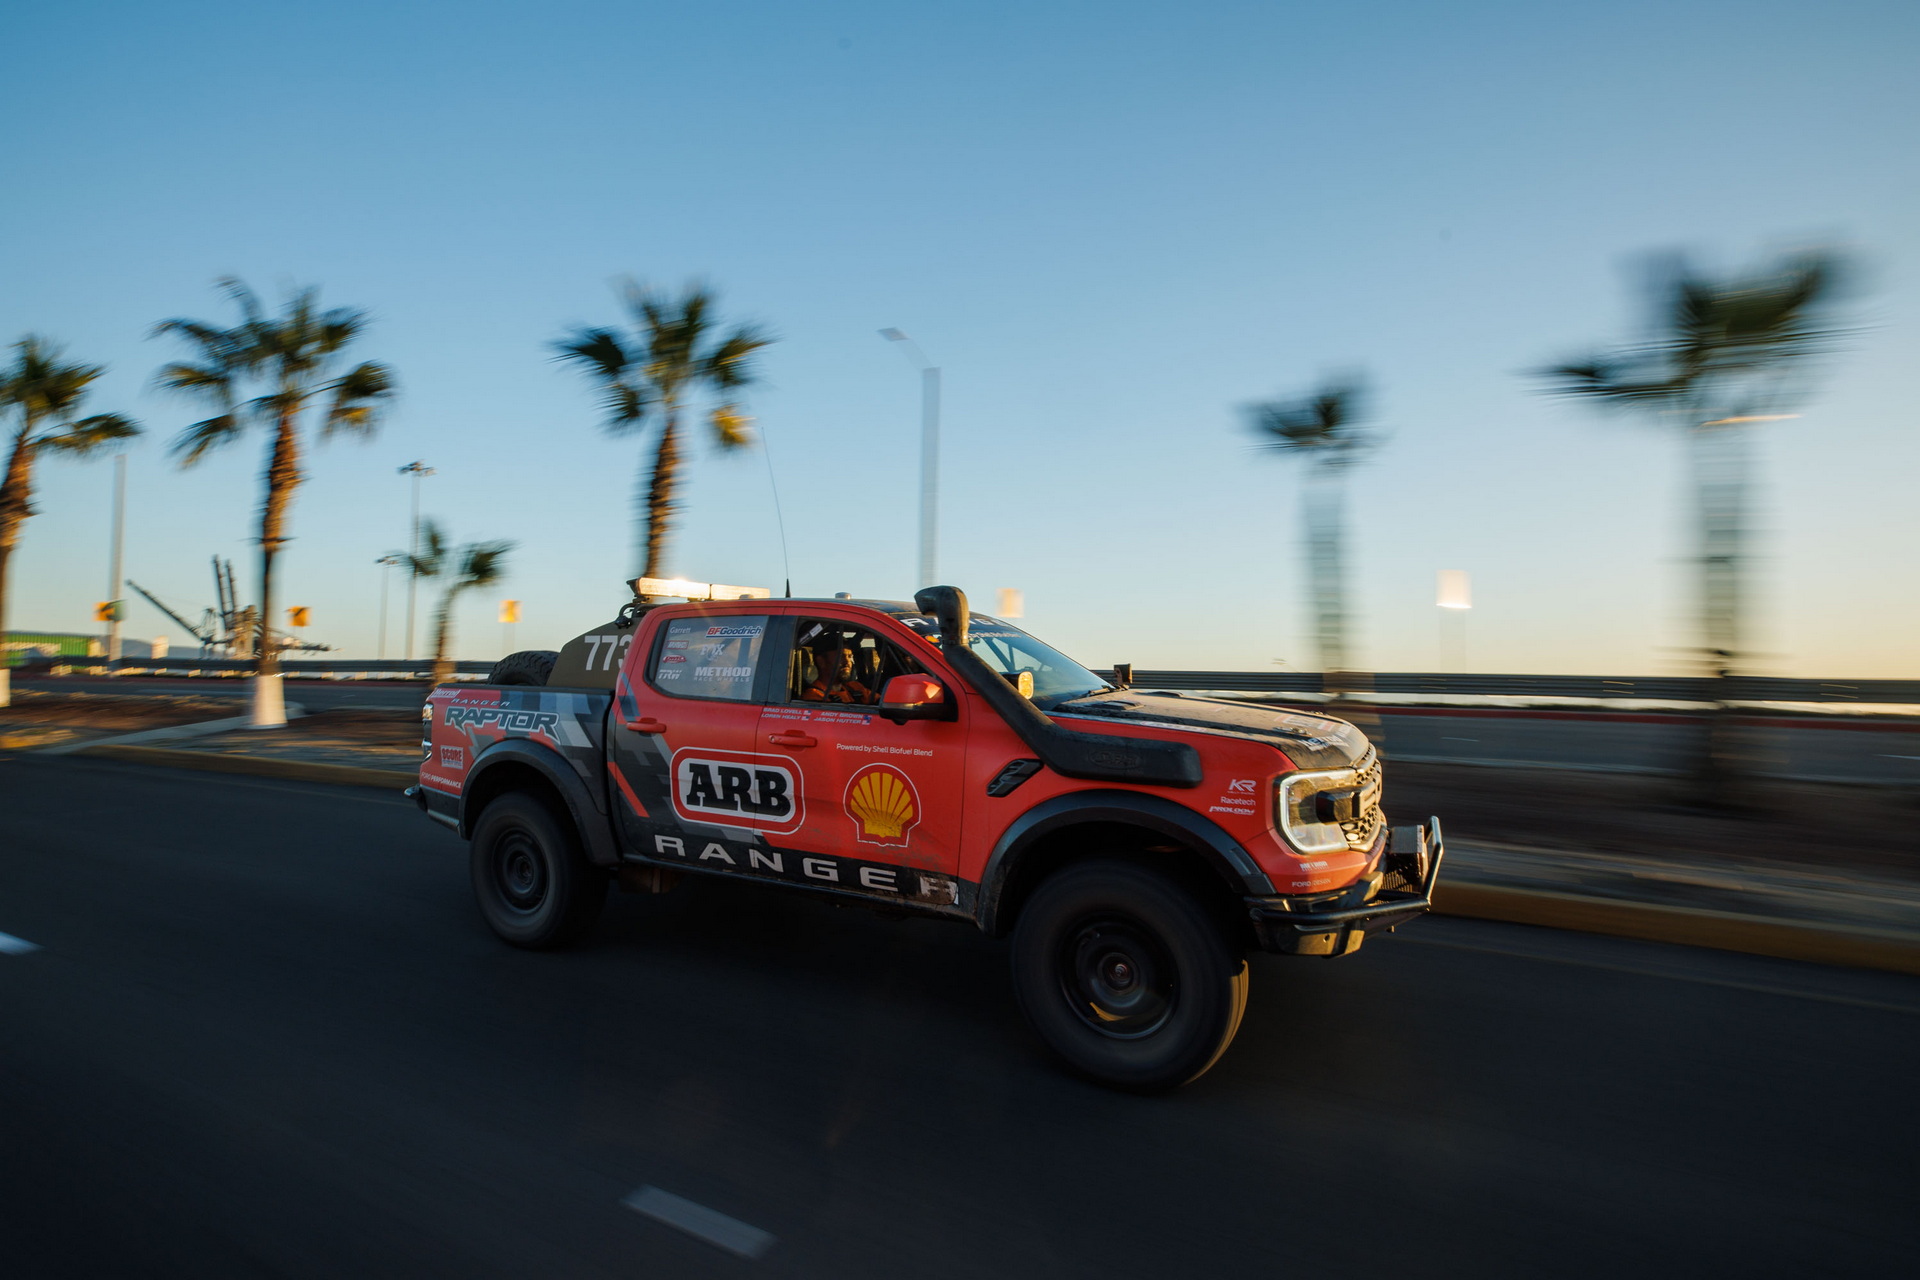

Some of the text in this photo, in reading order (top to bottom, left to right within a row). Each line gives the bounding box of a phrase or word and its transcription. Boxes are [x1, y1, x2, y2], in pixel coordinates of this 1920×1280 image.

[670, 626, 691, 635] Garrett
[706, 626, 762, 636] BFGoodrich
[658, 669, 683, 680] TRW
[695, 666, 751, 677] METHOD
[451, 698, 511, 707] RANGER
[444, 706, 561, 745] RAPTOR
[441, 748, 462, 762] SCORE
[836, 743, 933, 757] Powered by Shell Biofuel Blend
[686, 763, 791, 817] ARB
[1228, 779, 1257, 792] KR
[1220, 796, 1256, 806] Racetech
[1292, 880, 1312, 888] FORD
